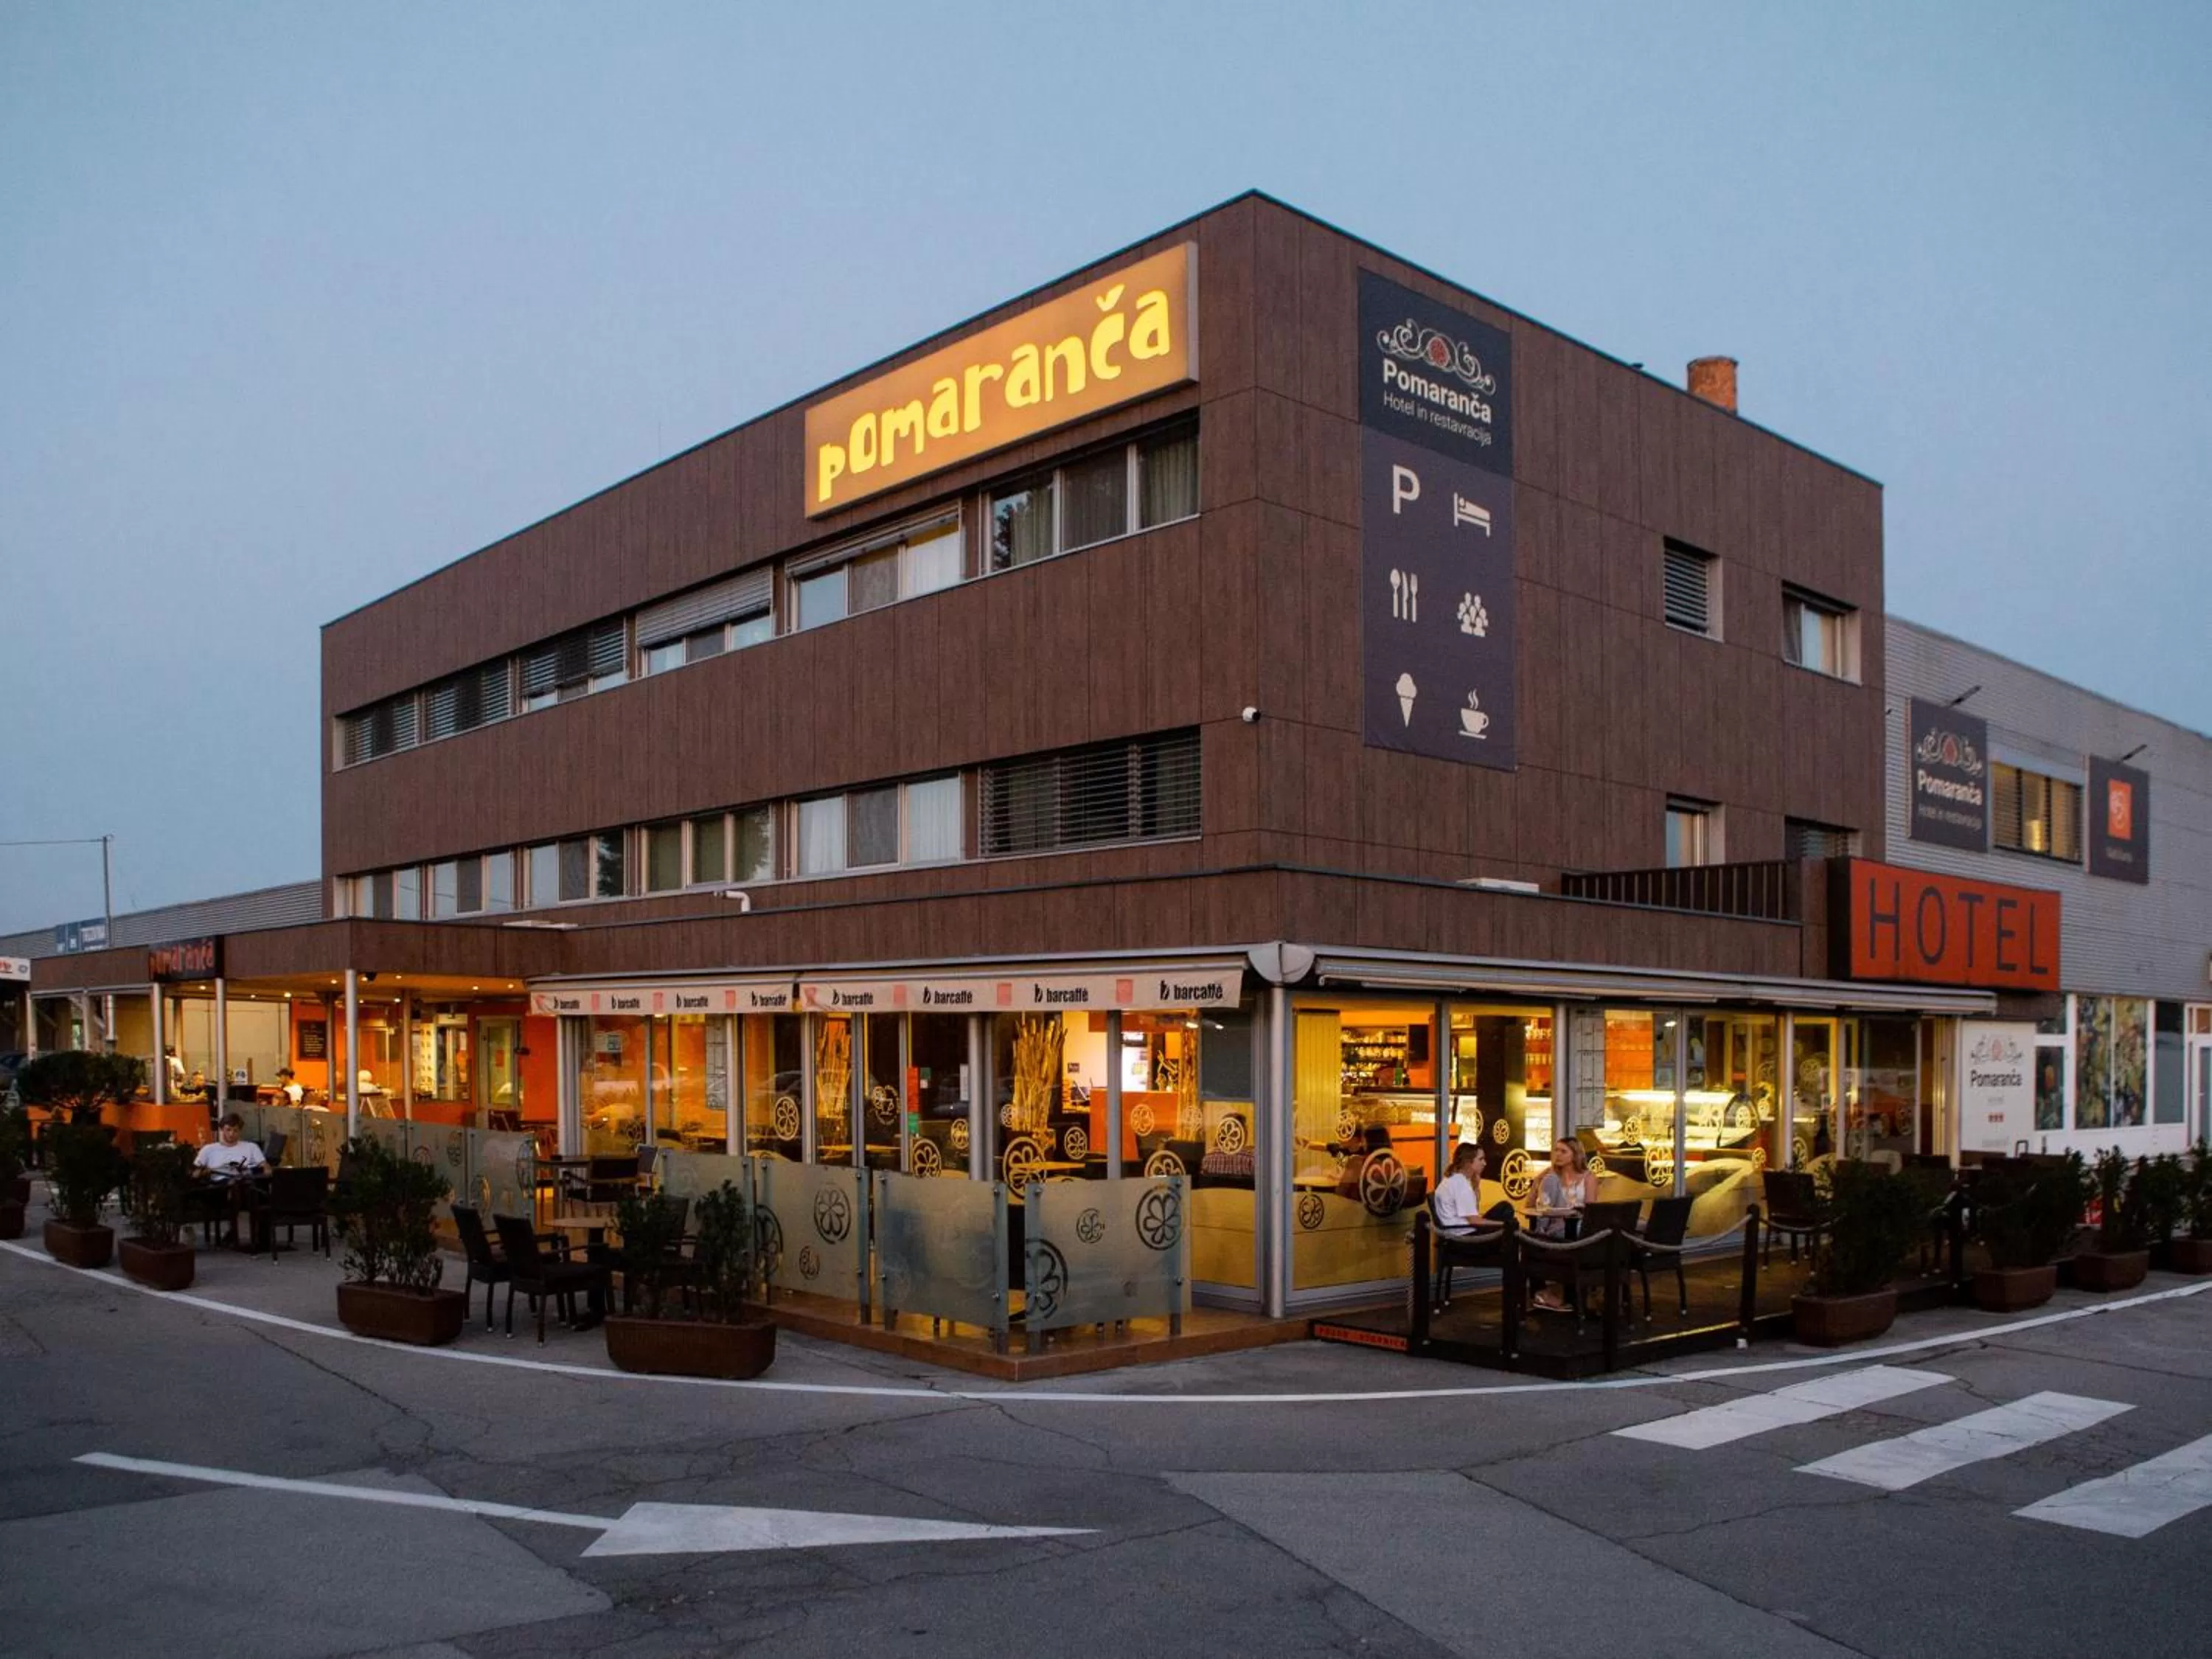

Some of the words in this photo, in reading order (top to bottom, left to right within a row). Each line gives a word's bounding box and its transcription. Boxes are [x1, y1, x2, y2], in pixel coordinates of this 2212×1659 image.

[818, 284, 1171, 503] pomaranča
[1382, 358, 1492, 424] Pomaranča
[1383, 389, 1415, 416] Hotel
[1417, 403, 1428, 422] in
[1429, 410, 1492, 448] restavracija
[1393, 463, 1421, 515] P
[1869, 878, 2048, 975] HOTEL
